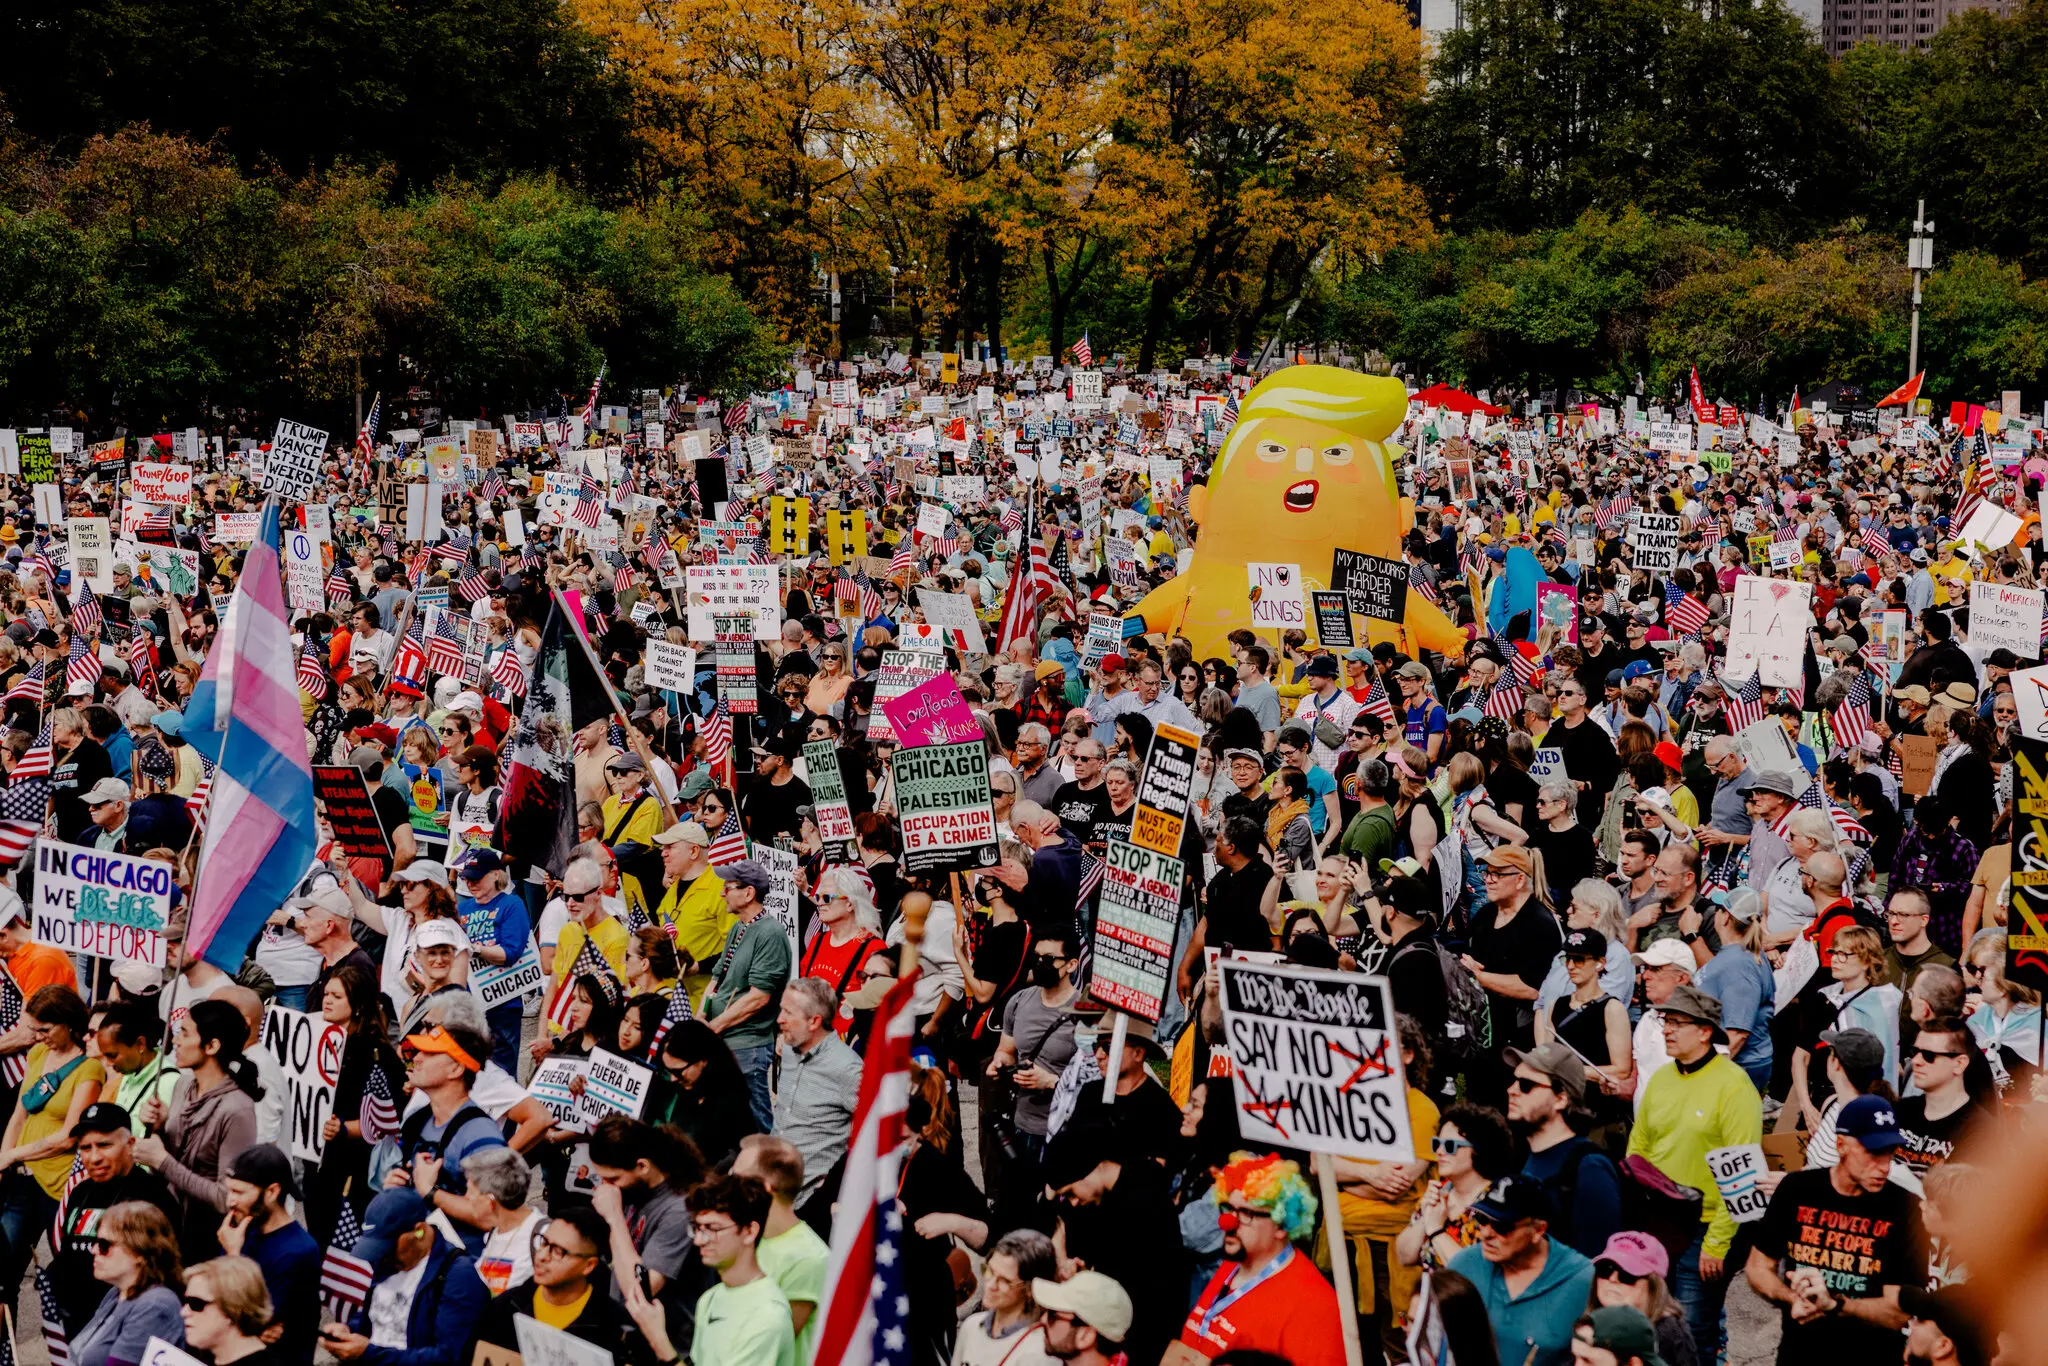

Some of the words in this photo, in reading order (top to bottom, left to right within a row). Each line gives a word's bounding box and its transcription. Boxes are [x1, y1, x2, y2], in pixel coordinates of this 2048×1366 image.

[1075, 374, 1099, 383] STOP
[1076, 385, 1098, 393] THE
[281, 420, 327, 441] TRUMP
[515, 424, 540, 434] RESIST
[1122, 425, 1139, 435] FAITH
[1652, 431, 1677, 439] SHOOK
[95, 442, 107, 450] NO
[277, 435, 323, 458] VANCE
[21, 454, 53, 467] FEAR
[273, 449, 315, 472] STILL
[1706, 456, 1730, 470] NO
[23, 470, 54, 482] WANT
[269, 461, 313, 485] WEIRD
[263, 476, 311, 502] DUDES
[229, 514, 260, 522] AMERICA
[700, 520, 713, 528] NOT
[1614, 516, 1639, 525] CHICAGO
[1639, 517, 1679, 531] LIARS
[1636, 533, 1678, 549] TYRANTS
[46, 546, 67, 558] HANDS
[1636, 550, 1671, 569] HEIRS
[52, 555, 66, 567] OFF!
[288, 562, 298, 571] NO
[1118, 560, 1135, 571] NOT
[1336, 552, 1352, 567] MY
[1356, 555, 1377, 572] DAD
[1379, 562, 1406, 580] WORKS
[288, 572, 299, 581] NO
[730, 568, 742, 576] NOT
[290, 583, 302, 594] NO
[1346, 569, 1391, 594] HARDER
[419, 588, 436, 596] HANDS
[1345, 587, 1367, 599] THAN
[1371, 592, 1390, 606] THE
[1743, 580, 1759, 601] I
[1976, 585, 1996, 600] THE
[1999, 589, 2041, 608] AMERICAN
[292, 595, 304, 608] NO
[306, 600, 322, 610] HATE
[729, 596, 739, 604] THE
[743, 596, 760, 604] HAND
[1318, 596, 1345, 617] NO!
[1253, 600, 1303, 622] KINGS
[1995, 605, 2019, 618] DREAM
[715, 621, 731, 634] STOP
[734, 619, 751, 633] THE
[903, 624, 909, 636] I
[1090, 614, 1110, 628] HANDS
[1110, 618, 1122, 629] OFF
[1767, 613, 1784, 638] A
[1974, 613, 2011, 628] BELONGED
[2017, 622, 2028, 630] TO
[903, 637, 940, 648] AMERICA
[1972, 627, 2020, 649] IMMIGRANTS
[2019, 637, 2039, 652] FIRST
[654, 643, 669, 653] PUSH
[671, 646, 687, 657] BACK
[657, 655, 682, 667] AGAINST
[883, 652, 915, 667] STOP
[918, 654, 944, 669] THE
[653, 665, 674, 675] TRUMP
[674, 670, 685, 678] and
[880, 666, 904, 674] TRUMP
[660, 677, 677, 688] MUSK
[1169, 741, 1183, 756] The
[895, 751, 921, 764] FROM
[1155, 749, 1191, 779] Trump
[896, 755, 984, 783] CHICAGO
[973, 776, 985, 786] TO
[1146, 766, 1190, 796] Fascist
[322, 788, 365, 799] STEALING
[415, 786, 433, 796] HANDS
[1141, 784, 1186, 814] Regime
[901, 788, 989, 812] PALESTINE
[903, 810, 990, 832] OCCUPATION
[1094, 822, 1105, 831] NO
[1105, 822, 1131, 833] KINGS
[1138, 809, 1163, 828] MUST
[1168, 821, 1181, 836] GO
[906, 834, 921, 848] IS
[928, 832, 938, 845] A
[943, 826, 992, 845] CRIME!
[1137, 826, 1177, 850] NOW!!!
[40, 846, 68, 876] IN
[71, 853, 169, 895] CHICAGO
[1109, 843, 1151, 873] STOP
[1156, 857, 1181, 886] THE
[1106, 865, 1137, 887] TRUMP
[1139, 875, 1179, 903] AGENDA!
[44, 884, 76, 909] WE
[1102, 880, 1135, 898] DEFEND
[1147, 894, 1179, 914] EXPAND
[1100, 891, 1148, 914] IMMIGRANT
[1150, 906, 1178, 923] RIGHTS
[1097, 918, 1115, 933] STOP
[1118, 926, 1144, 944] POLICE
[37, 918, 77, 947] NOT
[81, 918, 159, 964] DEPORT
[481, 965, 541, 1004] CHICAGO
[1234, 970, 1272, 1013] We
[1295, 980, 1374, 1027] People
[265, 1010, 312, 1075] NO
[1233, 1019, 1278, 1071] SAY
[1288, 1027, 1333, 1078] NO
[608, 1058, 630, 1075] MIGRA:
[537, 1070, 570, 1084] FUERA
[590, 1062, 622, 1089] FUERA
[626, 1080, 641, 1096] DE
[1287, 1079, 1396, 1145] KINGS
[1721, 1152, 1752, 1177] OFF
[1796, 1206, 1819, 1223] THE
[1818, 1210, 1871, 1235] POWER
[1872, 1220, 1893, 1238] OF
[1800, 1225, 1824, 1244] THE
[1825, 1231, 1876, 1256] PEOPLE
[1793, 1243, 1854, 1272] GREATER
